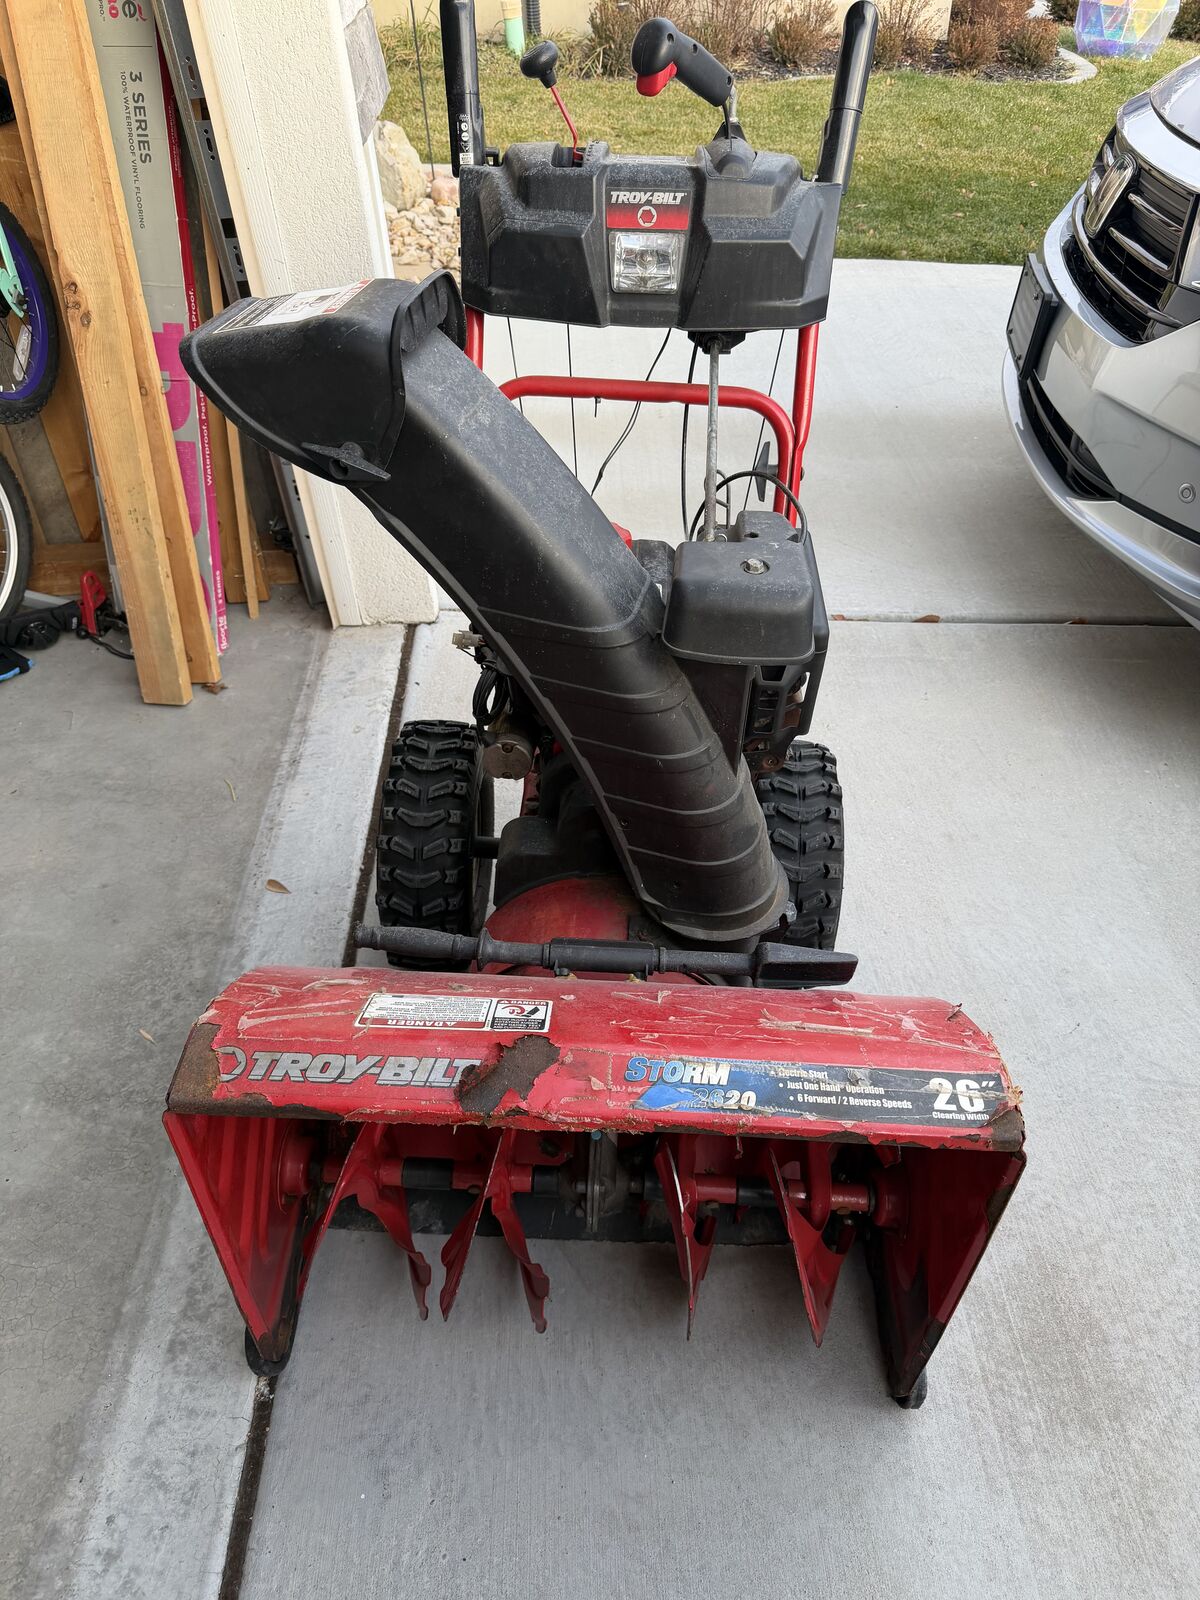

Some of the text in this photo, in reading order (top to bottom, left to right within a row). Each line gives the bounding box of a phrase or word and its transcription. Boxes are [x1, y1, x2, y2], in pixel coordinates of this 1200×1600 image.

[129, 71, 152, 165] 3 SERIES
[120, 71, 145, 229] 100% WATERPROOF VINYL FLOORING
[610, 191, 685, 205] TROY-BILT
[202, 422, 213, 486] Waterproof.
[387, 1019, 444, 1027] DANGER
[247, 1050, 482, 1088] TROY-BILT
[625, 1056, 732, 1086] STORM
[808, 1070, 829, 1079] Start
[787, 1080, 803, 1090] Just
[803, 1081, 819, 1091] One
[845, 1084, 885, 1095] Operation
[692, 1087, 757, 1111] 2620
[797, 1093, 803, 1102] 6
[804, 1094, 837, 1105] Forward
[843, 1096, 848, 1105] 2
[848, 1096, 881, 1108] Reverse
[882, 1099, 913, 1109] Speeds
[932, 1111, 990, 1121] Clearing Width
